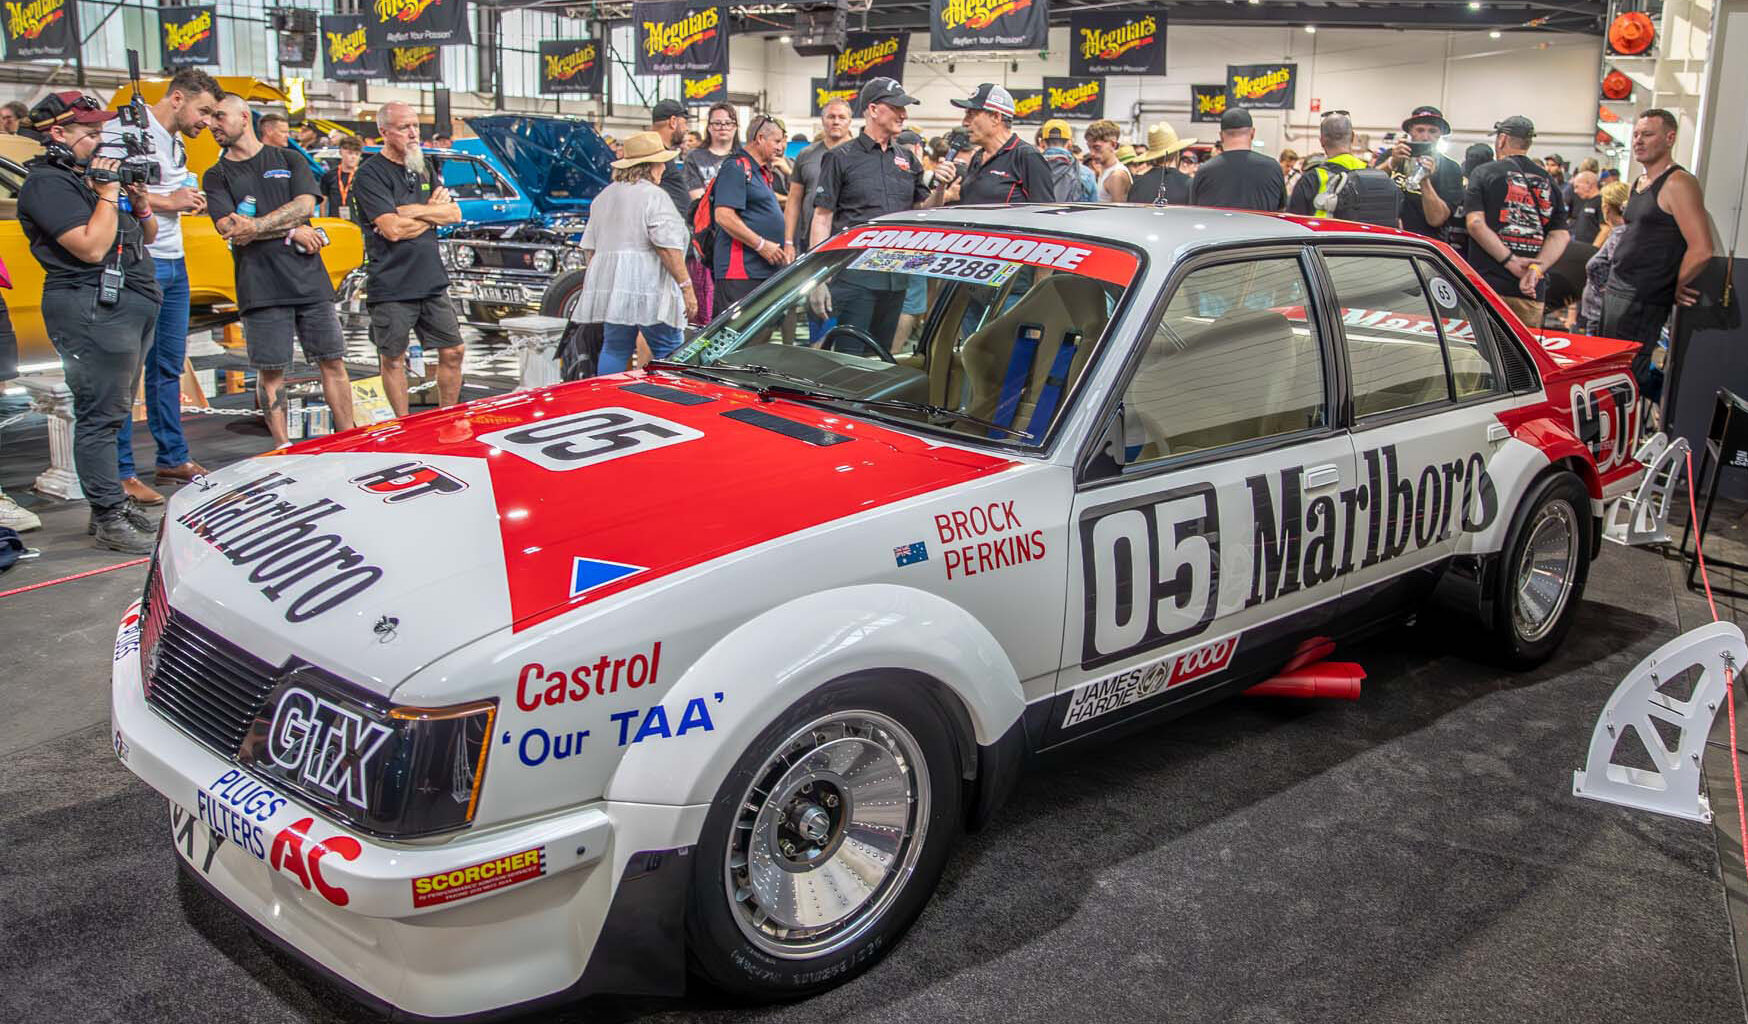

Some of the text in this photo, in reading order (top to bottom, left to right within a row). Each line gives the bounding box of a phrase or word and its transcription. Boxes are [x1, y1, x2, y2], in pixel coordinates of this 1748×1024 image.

[643, 6, 718, 57] Meguiar's
[1080, 16, 1156, 59] Meguiar's
[1048, 81, 1099, 109] Meguiar's
[848, 230, 1091, 270] COMMODORE
[928, 257, 1000, 280] 3288
[1437, 285, 1450, 300] 65
[504, 413, 683, 460] 05
[934, 500, 1021, 544] BROCK
[1244, 444, 1498, 606] Marlboro
[176, 471, 383, 622] Marlboro
[944, 530, 1046, 580] PERKINS
[1092, 494, 1211, 655] 05
[516, 641, 661, 712] Castrol
[1177, 640, 1228, 676] 1000
[1067, 686, 1134, 725] HARDIE
[1076, 669, 1141, 705] JAMES
[268, 687, 393, 810] GTX
[209, 769, 287, 822] PLUGS
[198, 789, 265, 860] FILTERS
[270, 817, 362, 906] AC
[415, 849, 539, 894] SCORCHER
